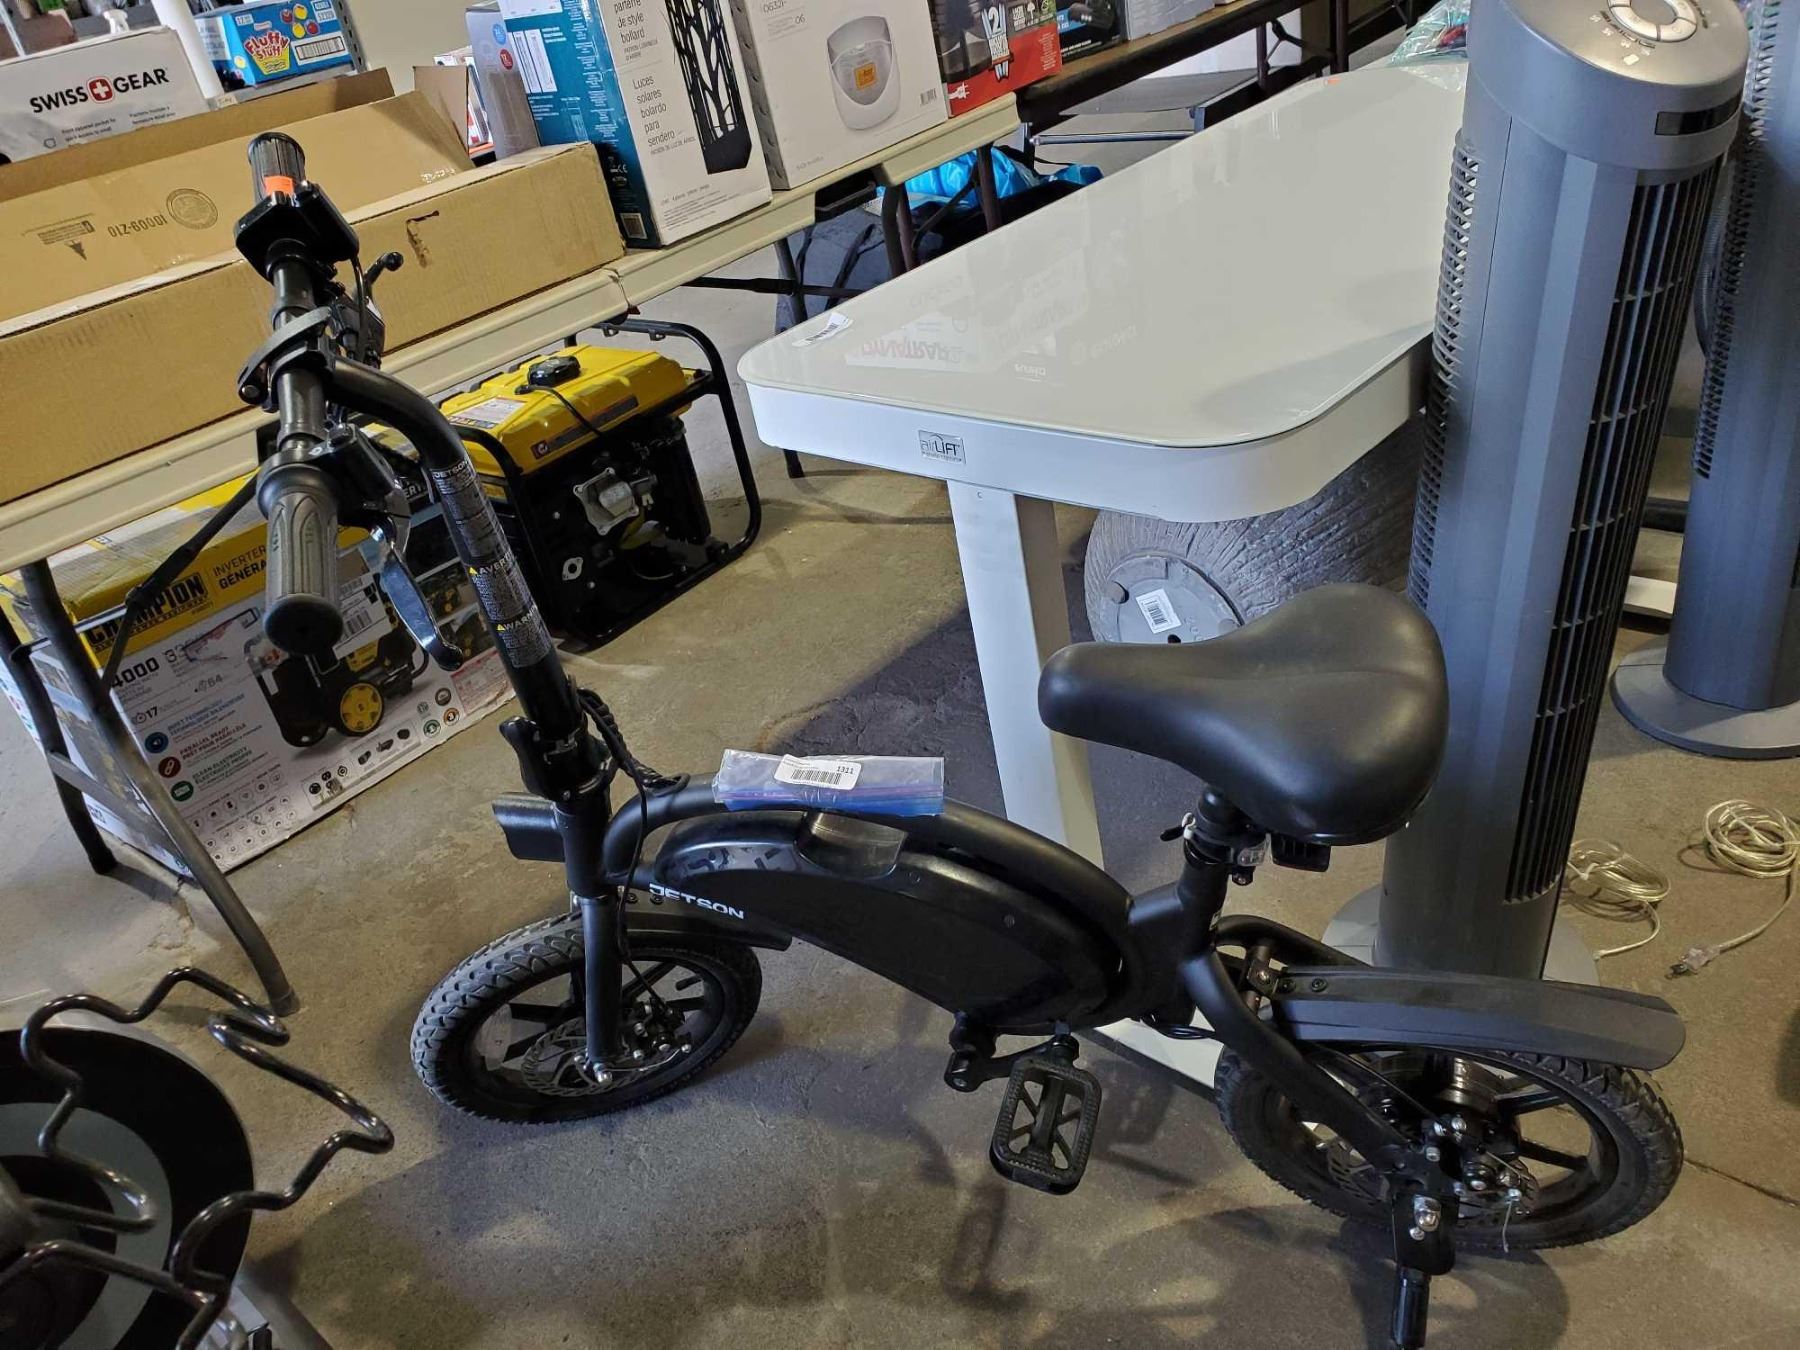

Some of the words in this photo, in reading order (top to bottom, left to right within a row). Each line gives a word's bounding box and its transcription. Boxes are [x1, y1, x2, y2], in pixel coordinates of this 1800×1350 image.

[618, 16, 627, 28] de
[628, 12, 645, 26] style
[620, 27, 645, 44] bollard
[30, 86, 89, 113] SWISS
[113, 68, 170, 93] GEAR
[633, 76, 655, 90] Luces
[636, 89, 662, 104] solares
[641, 102, 667, 118] bolardo
[645, 120, 660, 134] para
[648, 130, 675, 147] sendero
[111, 656, 160, 688] 4000
[146, 706, 159, 719] 17
[648, 882, 745, 920] JETSON
